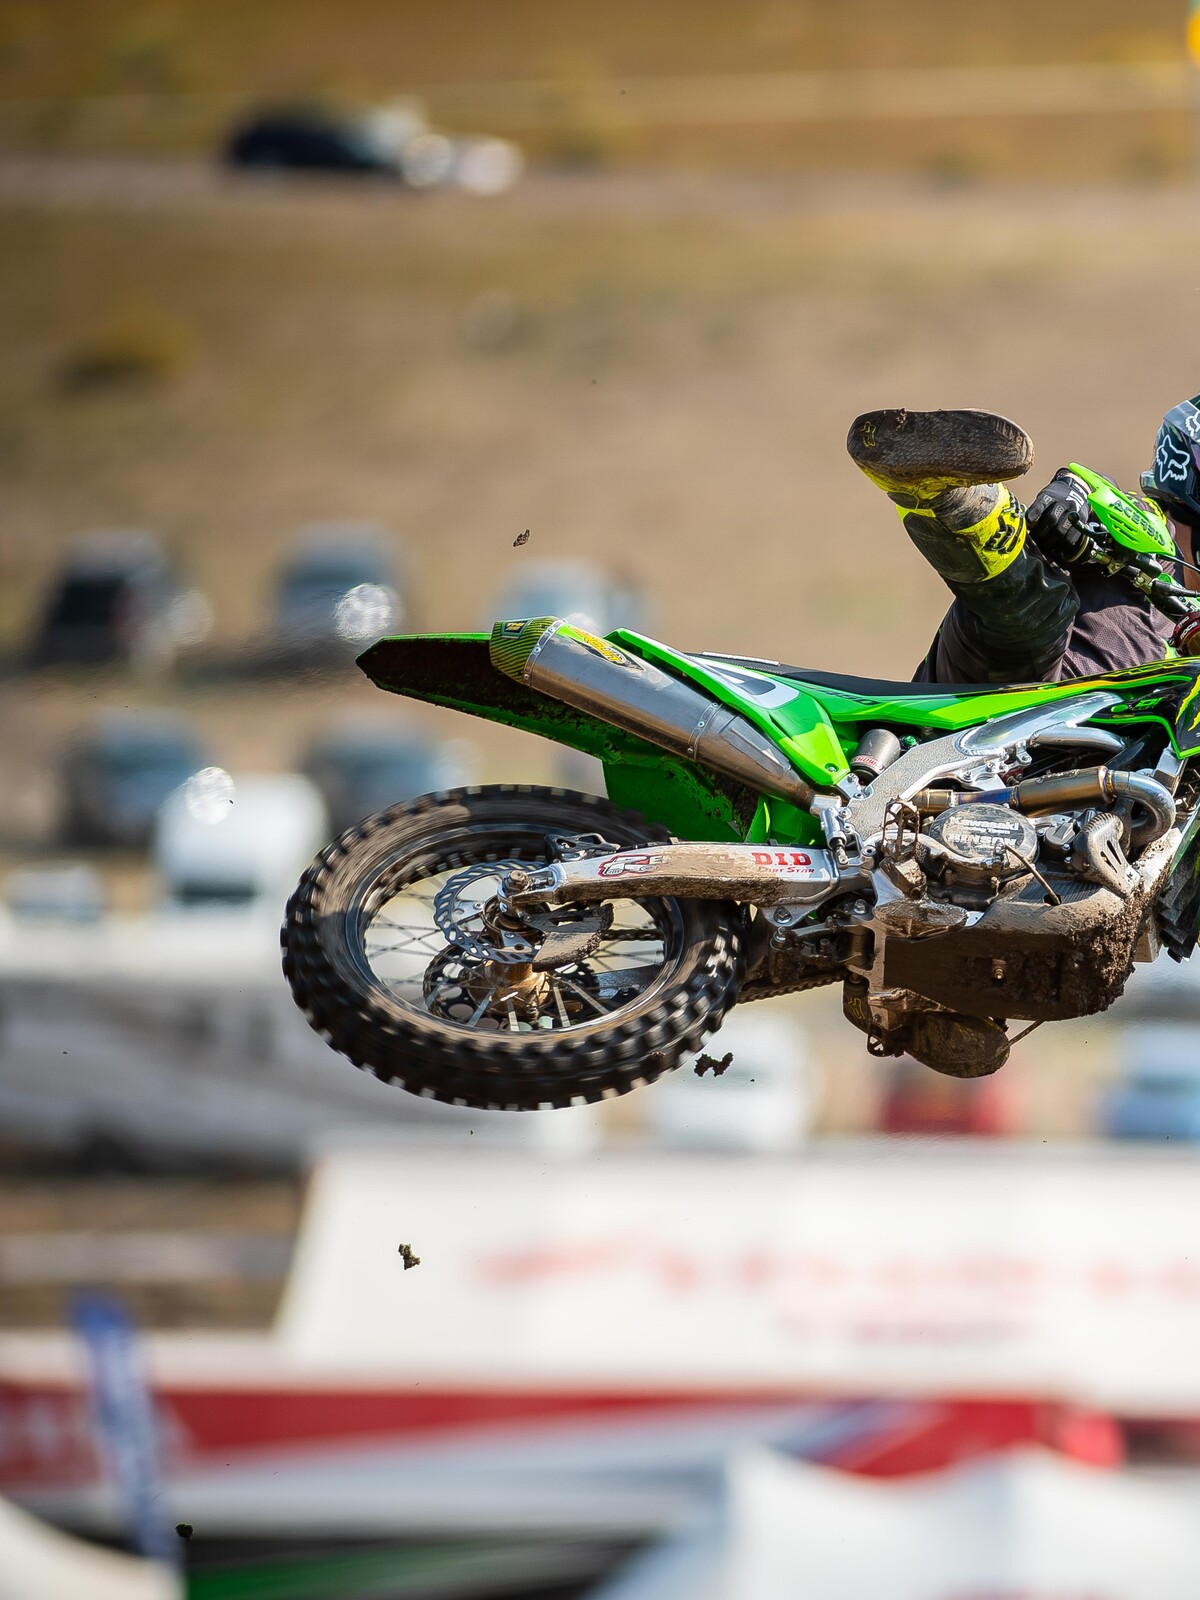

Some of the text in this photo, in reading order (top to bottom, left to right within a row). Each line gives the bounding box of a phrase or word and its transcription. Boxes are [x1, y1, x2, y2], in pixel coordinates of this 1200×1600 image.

[1109, 499, 1167, 547] ACERBIS
[947, 816, 1020, 831] Kawasaki
[751, 852, 812, 866] D.I.D
